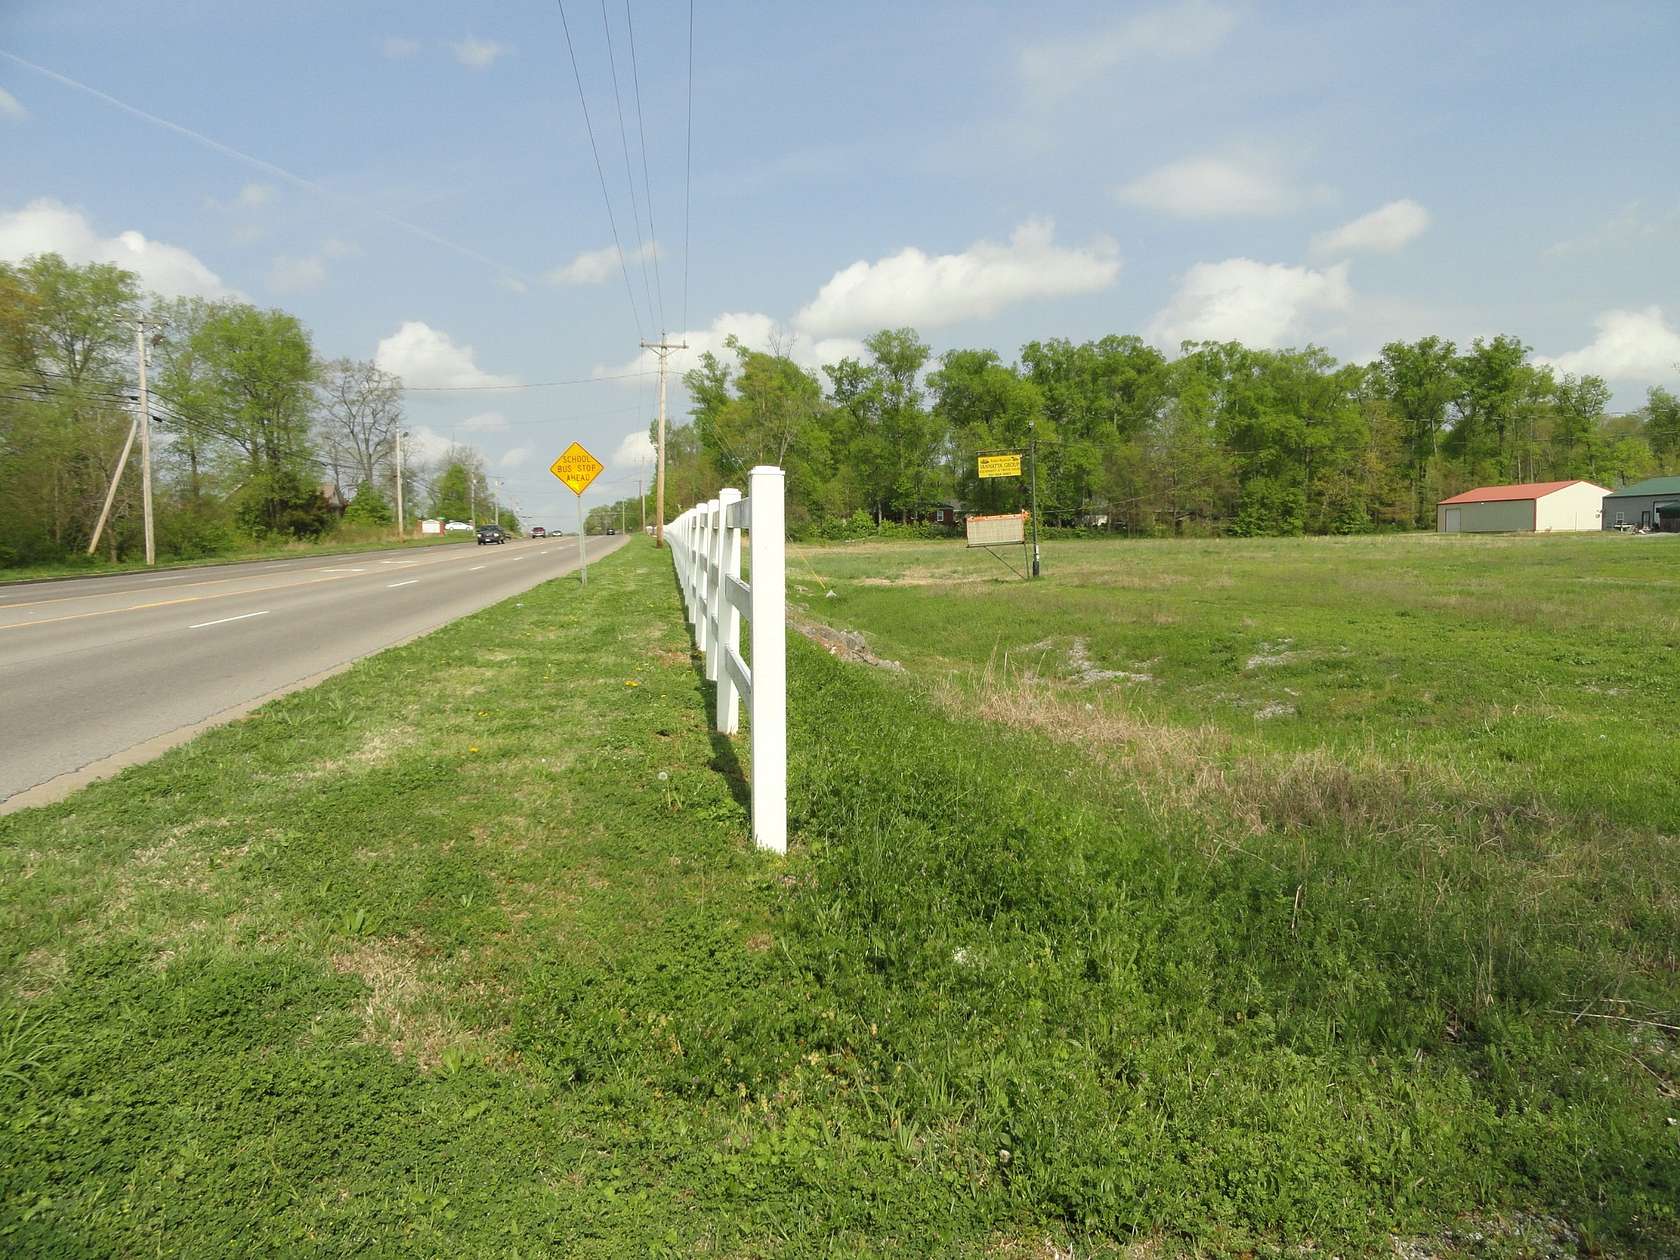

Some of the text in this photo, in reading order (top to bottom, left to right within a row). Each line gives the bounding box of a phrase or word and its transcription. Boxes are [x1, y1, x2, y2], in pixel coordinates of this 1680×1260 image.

[563, 455, 592, 463] SCHOOL
[557, 464, 597, 473] BUS STOP
